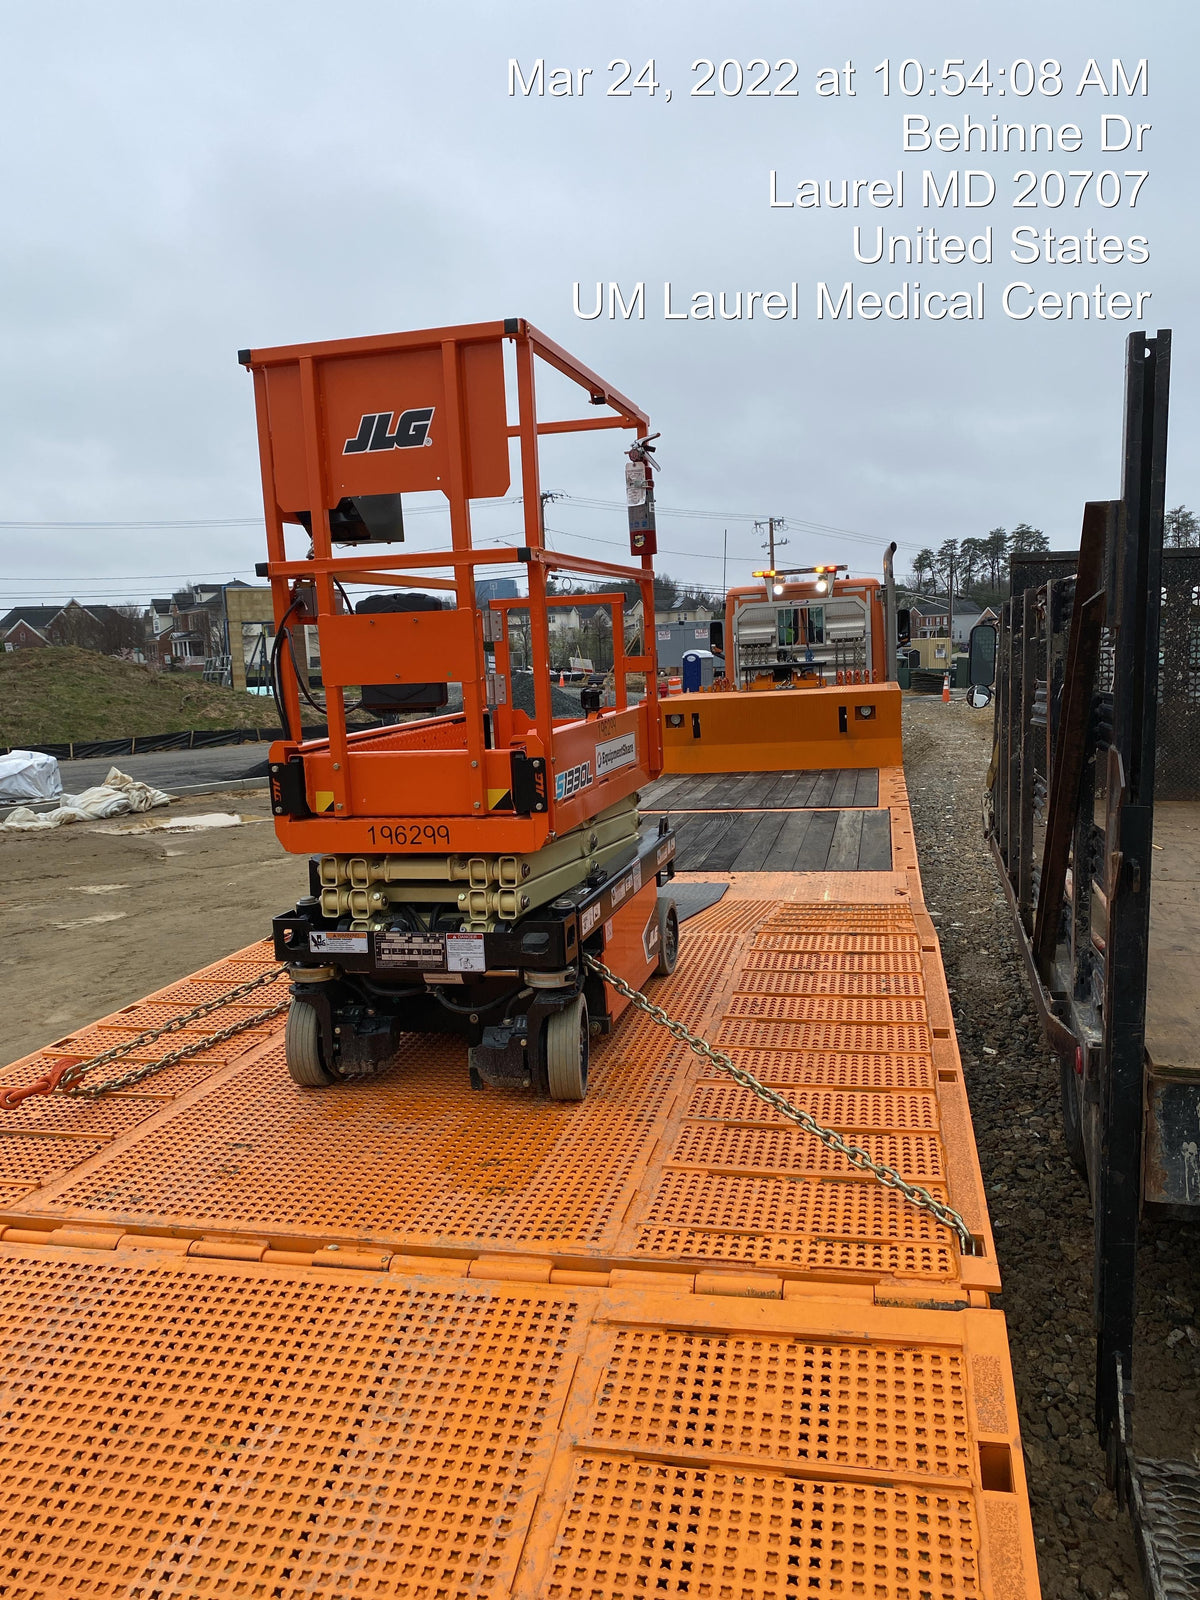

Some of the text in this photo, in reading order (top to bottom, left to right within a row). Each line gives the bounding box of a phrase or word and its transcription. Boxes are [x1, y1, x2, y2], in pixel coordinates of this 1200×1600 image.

[342, 406, 436, 455] JLG
[602, 743, 634, 766] EquipmentShare
[273, 777, 282, 803] JLG
[534, 771, 544, 799] JLG
[367, 825, 451, 845] 196299
